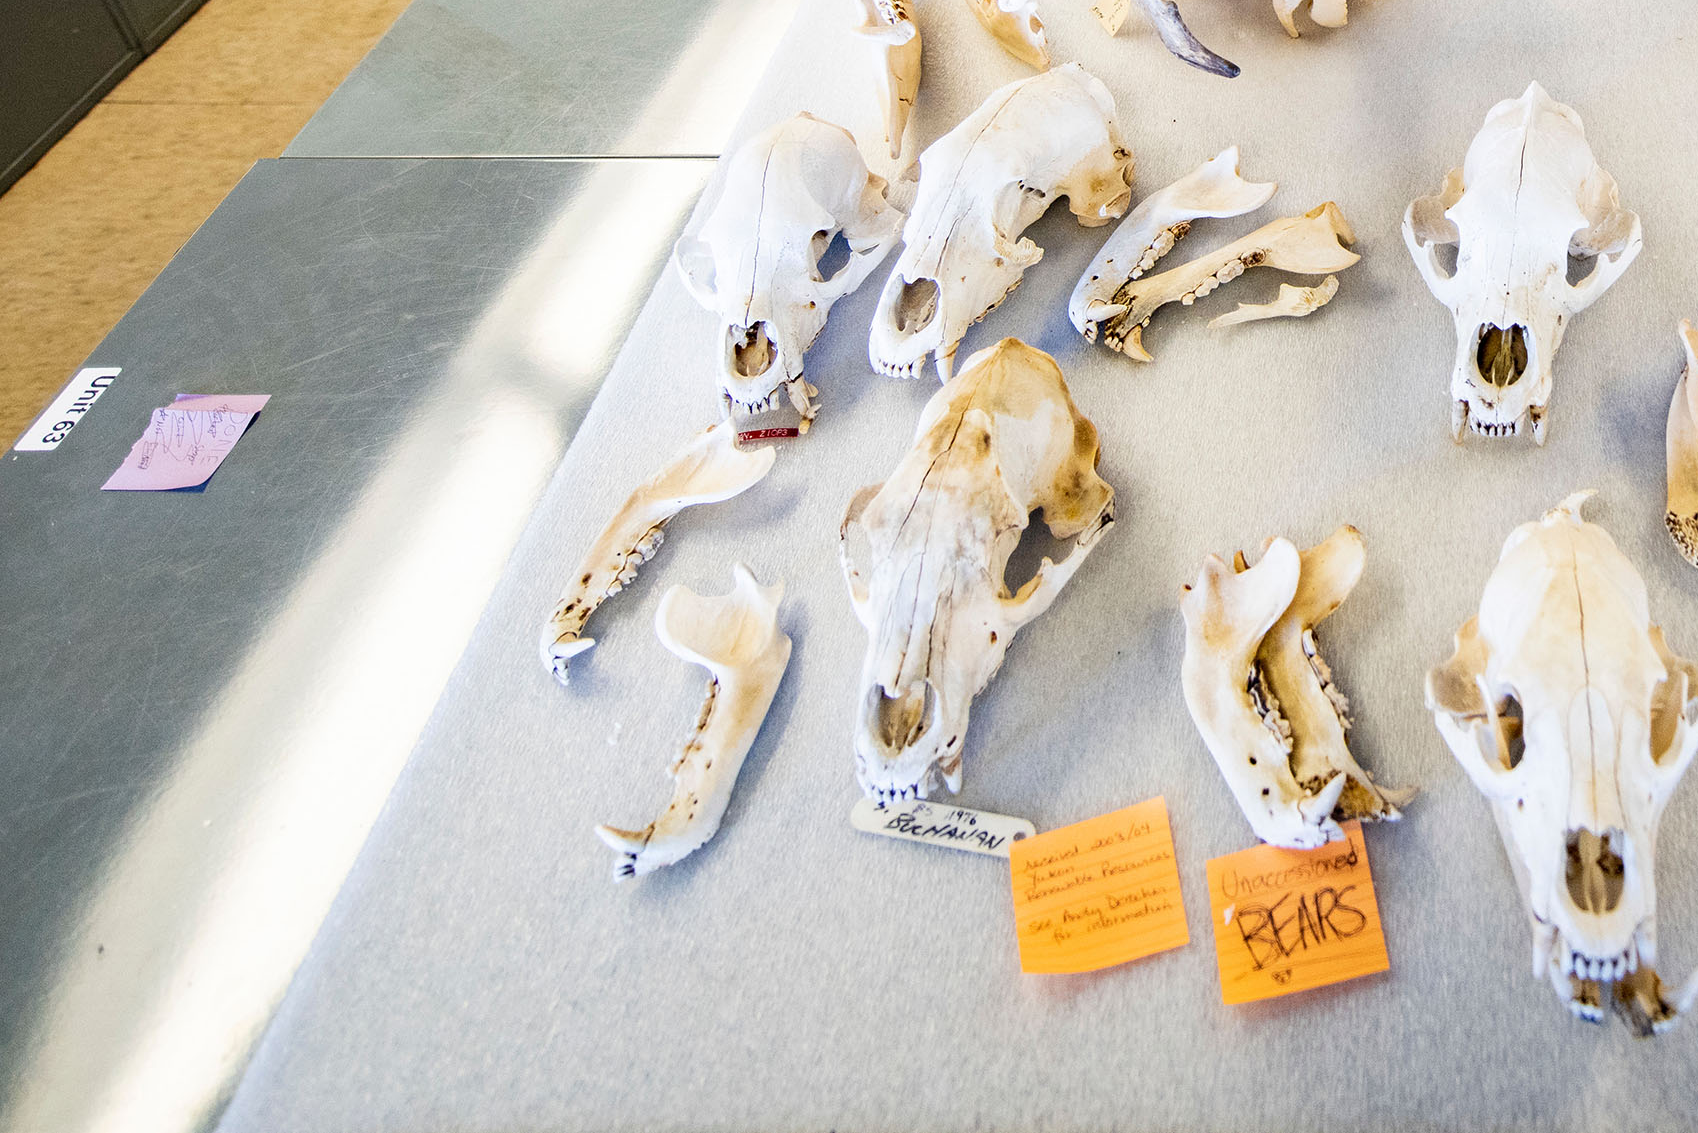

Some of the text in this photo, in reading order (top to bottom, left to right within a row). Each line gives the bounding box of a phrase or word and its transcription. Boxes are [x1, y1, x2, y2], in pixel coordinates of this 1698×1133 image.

[41, 375, 117, 444] Unit 63
[884, 812, 1006, 850] BUCHANAN
[1235, 884, 1368, 972] BEARS
